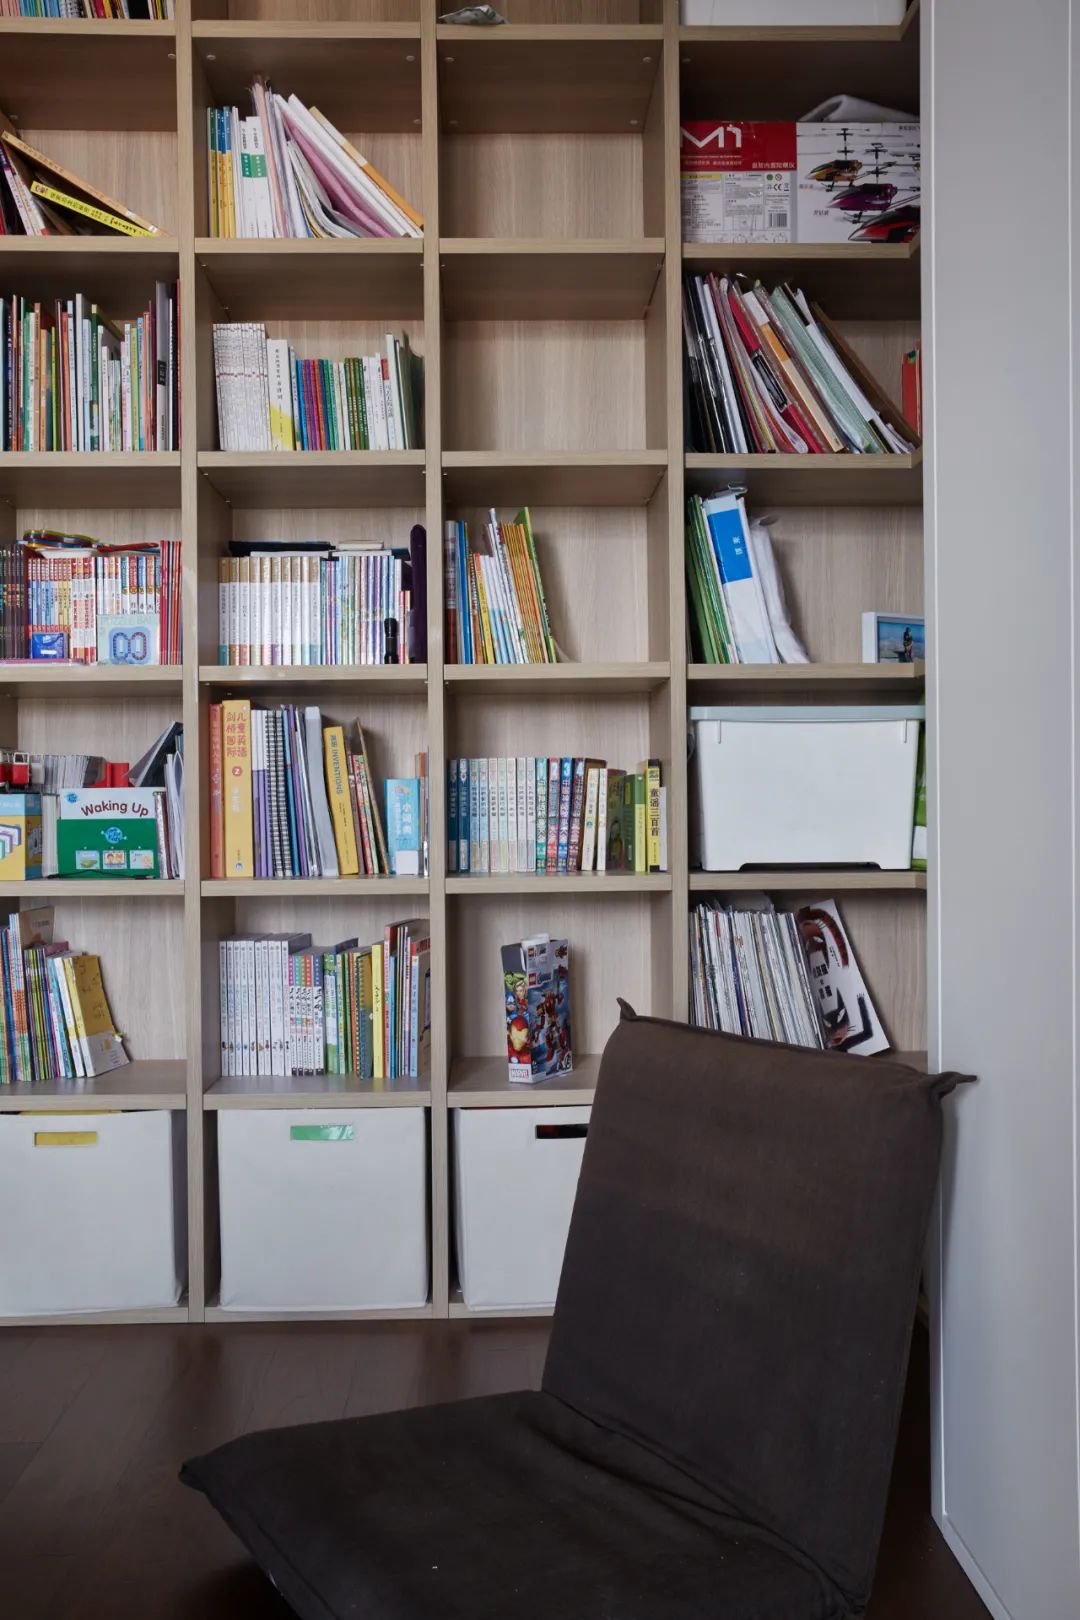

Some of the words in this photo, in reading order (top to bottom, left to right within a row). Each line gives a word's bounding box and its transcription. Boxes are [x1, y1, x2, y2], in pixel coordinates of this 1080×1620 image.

[332, 749, 344, 796] INVENTIONS
[563, 762, 571, 777] 3
[576, 762, 584, 776] 4
[81, 800, 128, 817] Waking
[132, 802, 149, 817] Up
[649, 788, 660, 837] 童谣三百首
